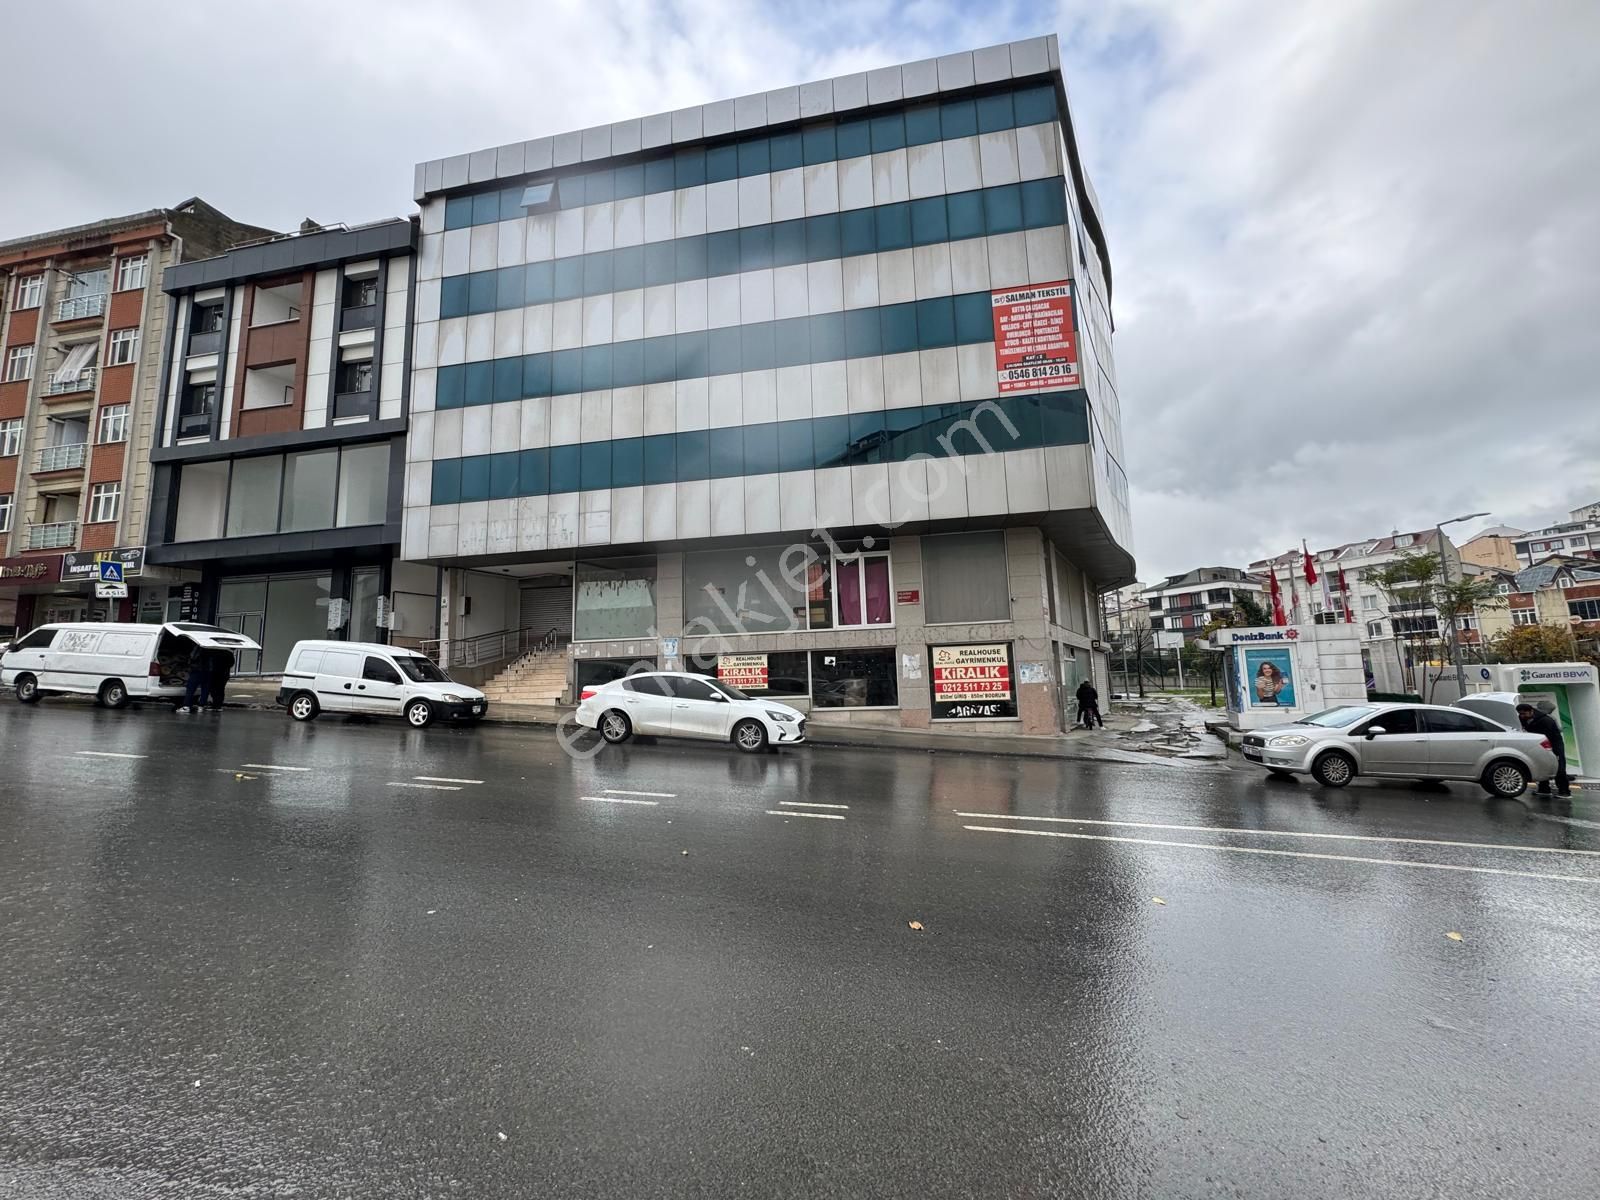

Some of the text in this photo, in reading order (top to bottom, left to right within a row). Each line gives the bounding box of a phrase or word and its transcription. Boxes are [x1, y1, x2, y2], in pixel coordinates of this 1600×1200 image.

[1006, 287, 1066, 302] SALMAN TEKSTİL
[1008, 364, 1072, 380] 0546 814 29 16
[1232, 632, 1284, 641] DenizBank
[955, 656, 1006, 664] GAYRİMENKUL
[942, 682, 1002, 692] 0212 511 73 25
